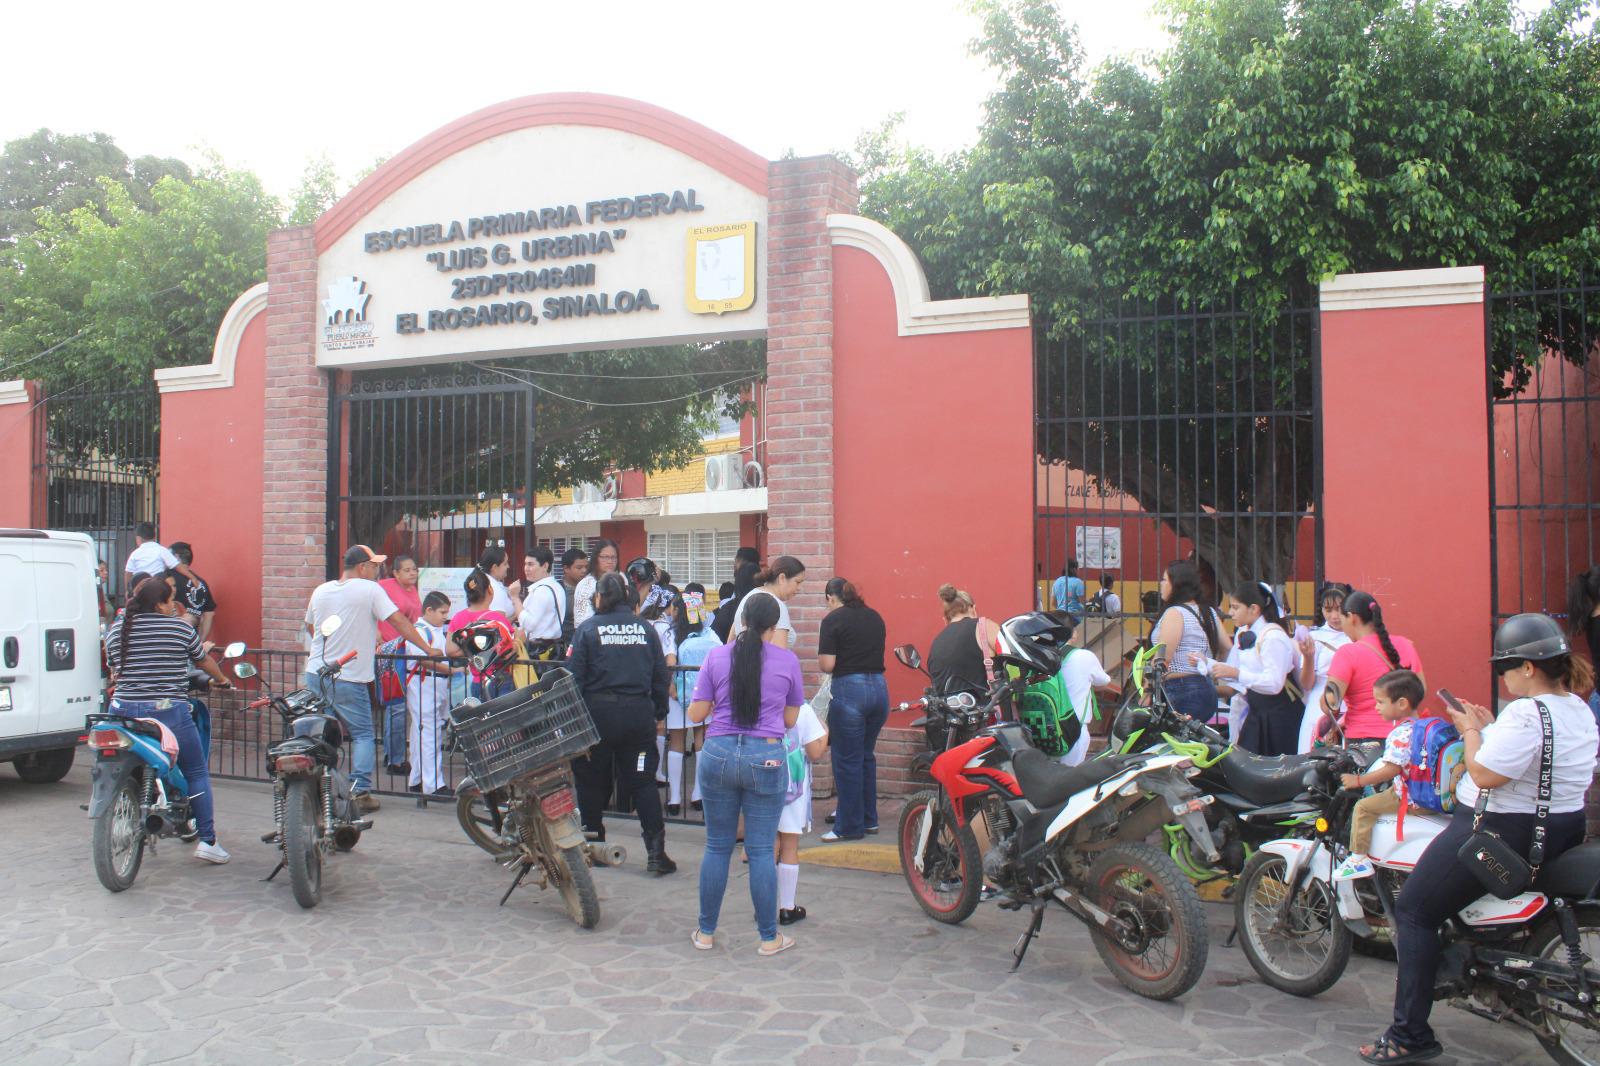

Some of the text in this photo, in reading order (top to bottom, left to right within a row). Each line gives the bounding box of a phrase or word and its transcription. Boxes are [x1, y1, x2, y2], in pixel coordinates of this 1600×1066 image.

[364, 188, 705, 254] ESCUELA PRIMARIA FEDERAL
[706, 223, 748, 233] ROSARIO
[491, 243, 517, 265] G.
[451, 263, 596, 300] 25DPR0464M
[396, 288, 660, 335] EL ROSARIO, SINALOA.
[597, 622, 646, 635] POLICÍA
[600, 634, 648, 646] MUNICIPAL
[66, 696, 91, 704] RAM
